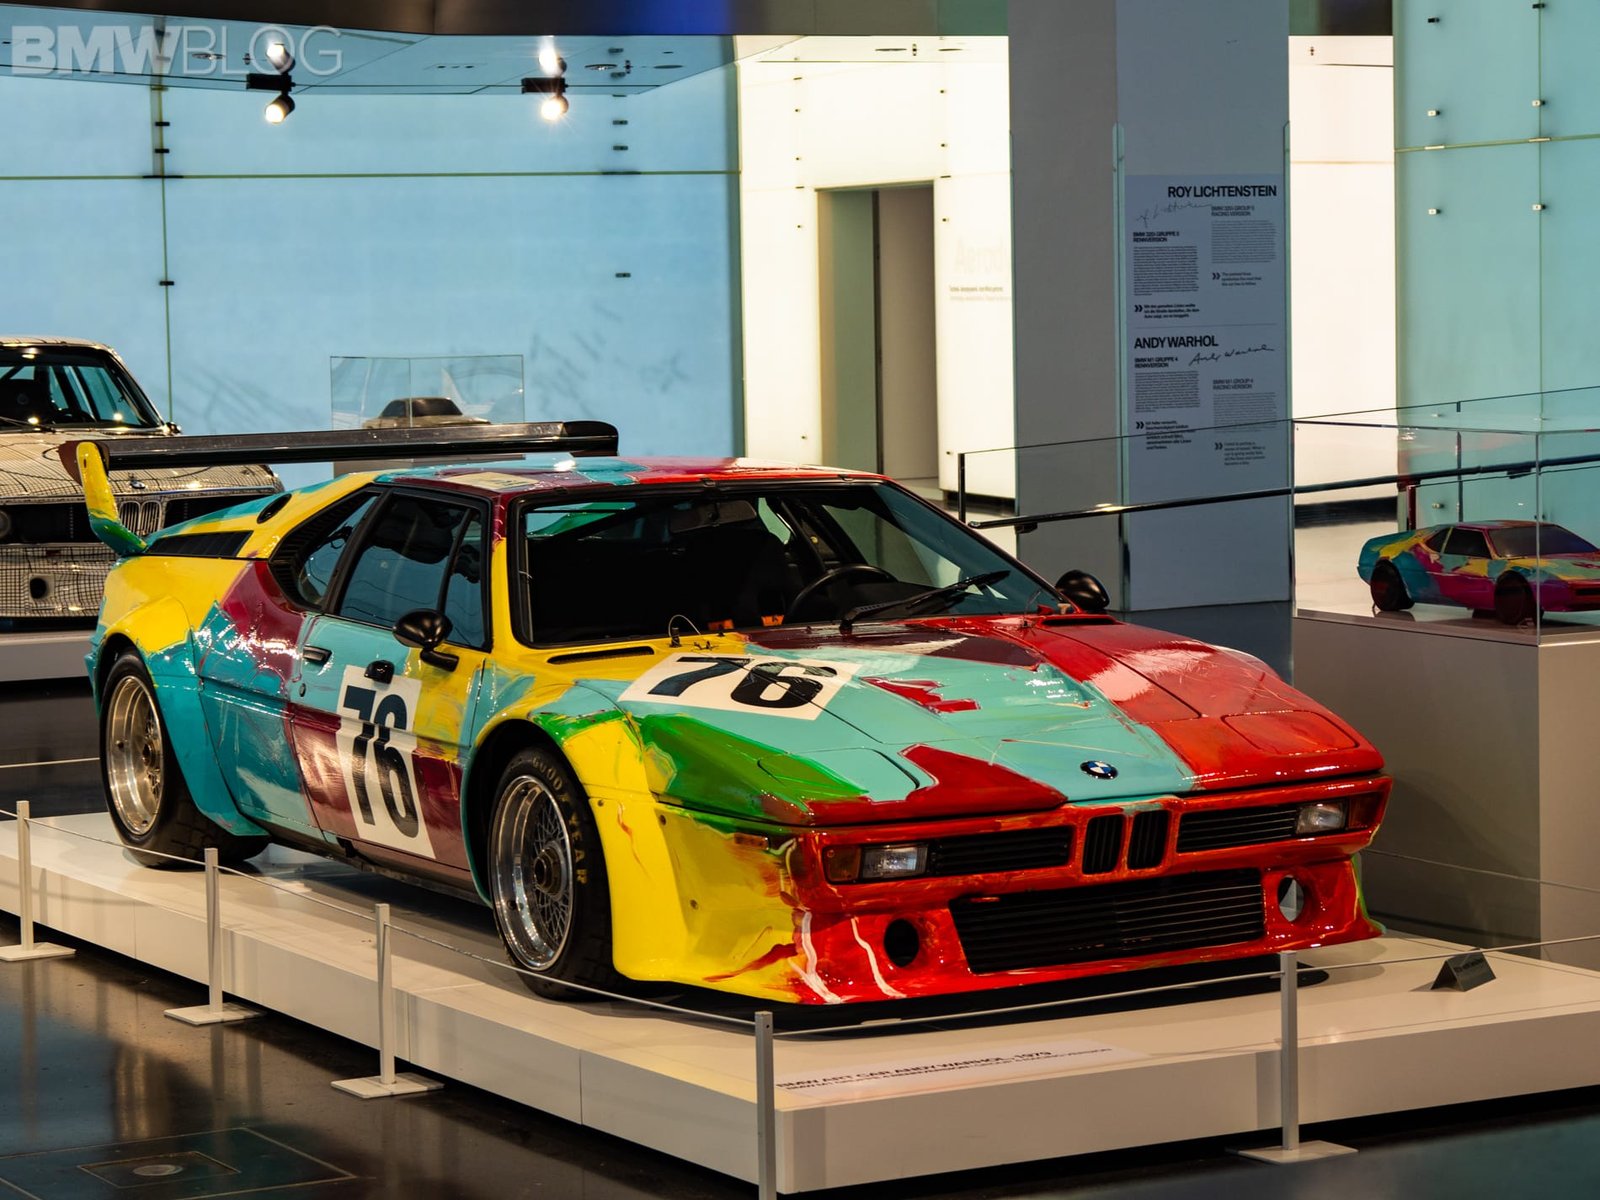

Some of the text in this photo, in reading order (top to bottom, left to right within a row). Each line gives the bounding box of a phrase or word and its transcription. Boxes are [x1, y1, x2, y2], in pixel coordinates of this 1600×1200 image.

[1168, 185, 1277, 198] ROY LICHTENSTEIN
[1134, 335, 1219, 349] ANDY WARHOL
[647, 656, 838, 709] 76
[342, 685, 420, 839] 76
